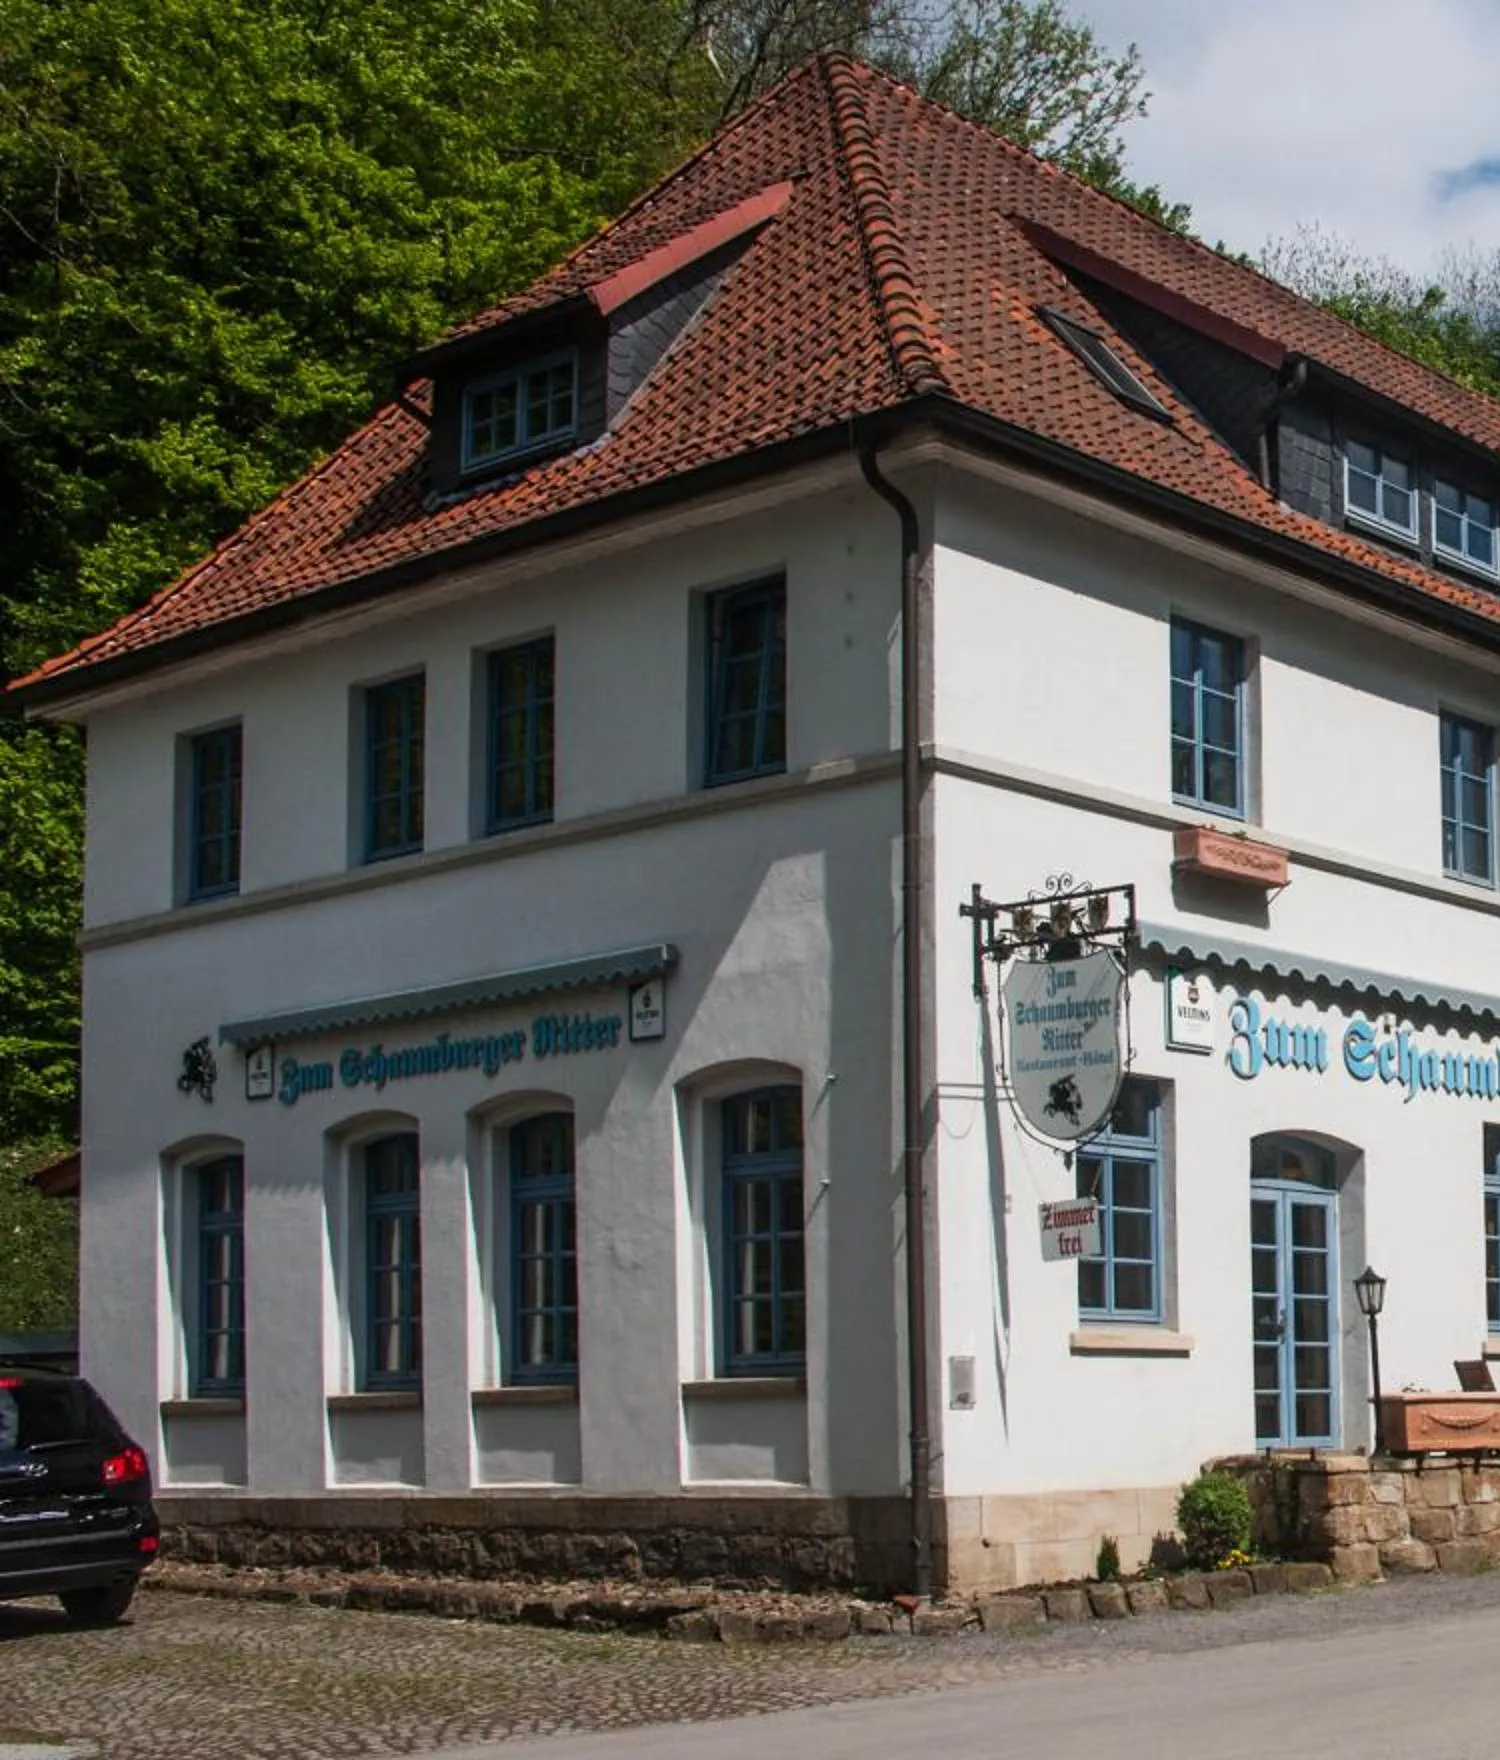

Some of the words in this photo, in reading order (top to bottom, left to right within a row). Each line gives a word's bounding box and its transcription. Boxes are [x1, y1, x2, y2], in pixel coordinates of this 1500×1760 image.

[1046, 966, 1077, 997] Zum
[1015, 996, 1112, 1029] Schaumburger
[1042, 1026, 1083, 1053] Ritter
[1226, 996, 1329, 1081] Zum
[278, 1057, 334, 1106] Zum
[340, 1025, 528, 1092] Schaumburger
[531, 1012, 623, 1059] Ritter
[1041, 1203, 1095, 1231] Zimmer
[1058, 1229, 1083, 1256] frei
